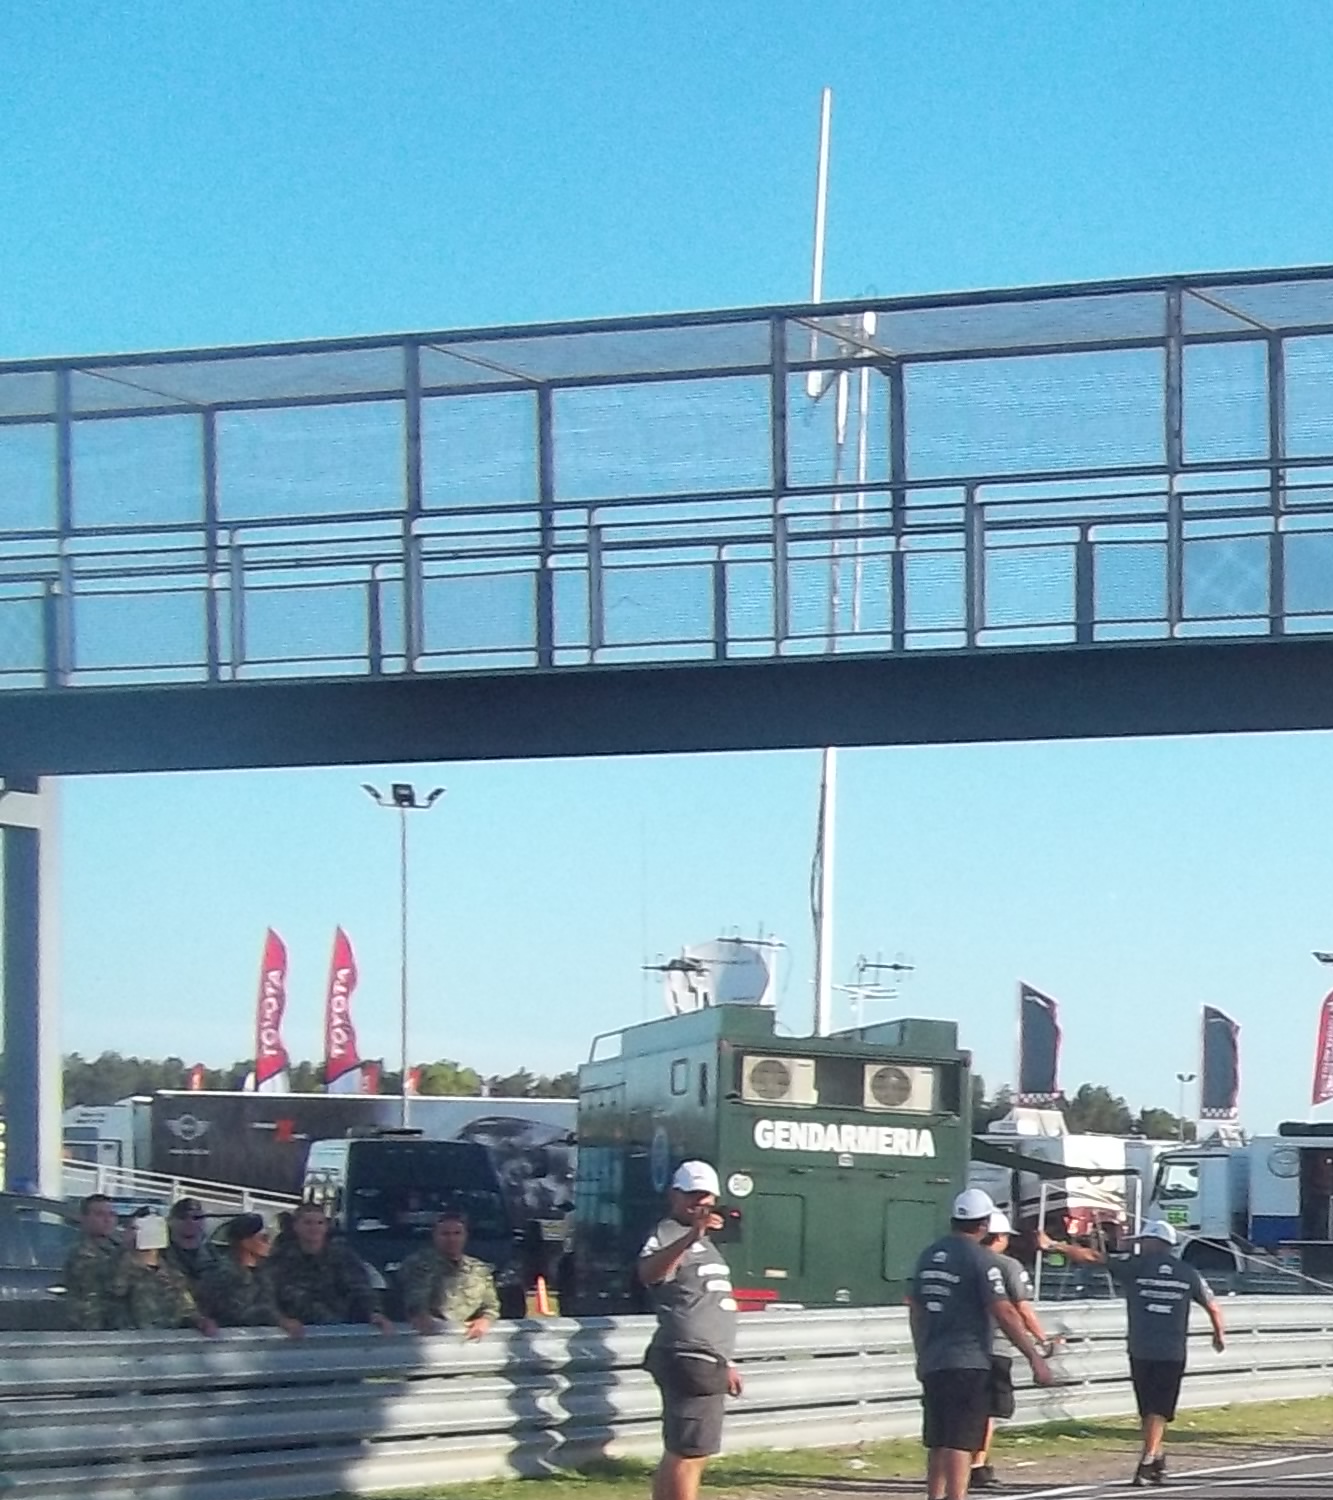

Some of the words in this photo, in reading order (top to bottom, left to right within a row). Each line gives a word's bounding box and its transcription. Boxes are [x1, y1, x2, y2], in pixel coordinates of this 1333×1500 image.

[261, 969, 284, 1057] TOYOTA
[331, 968, 351, 1059] TOYOTA
[753, 1119, 936, 1158] GENDARMERIA
